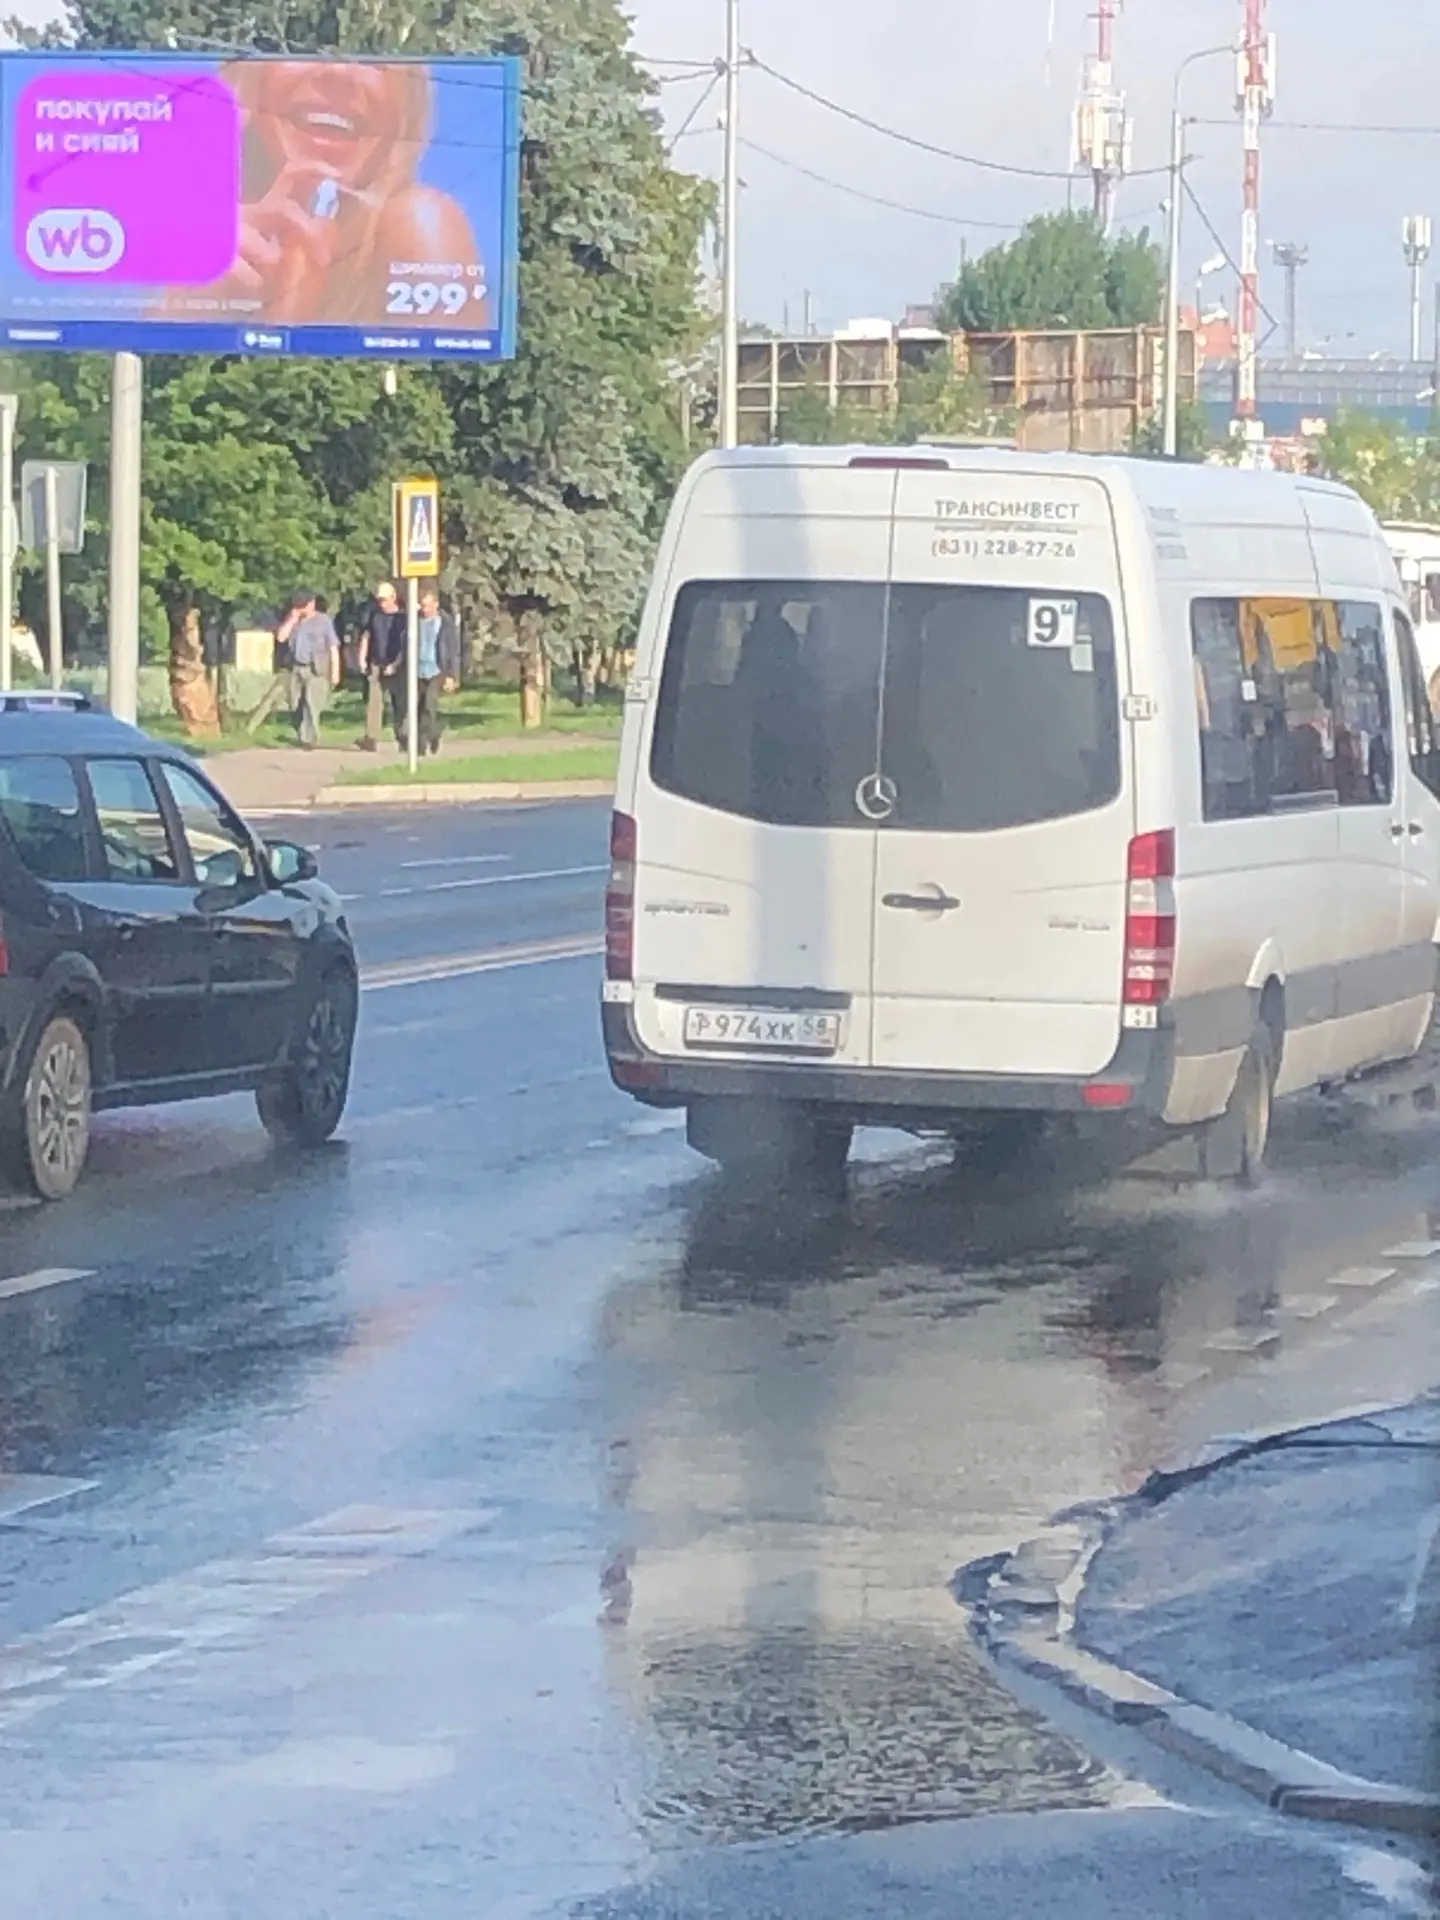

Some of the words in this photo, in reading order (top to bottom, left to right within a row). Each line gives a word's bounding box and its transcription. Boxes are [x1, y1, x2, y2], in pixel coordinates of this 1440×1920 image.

[35, 93, 173, 126] покупай
[35, 132, 54, 153] и
[63, 126, 140, 153] сияй
[38, 214, 113, 260] wb
[934, 499, 1081, 520] ТРАНСИНВЕСТ
